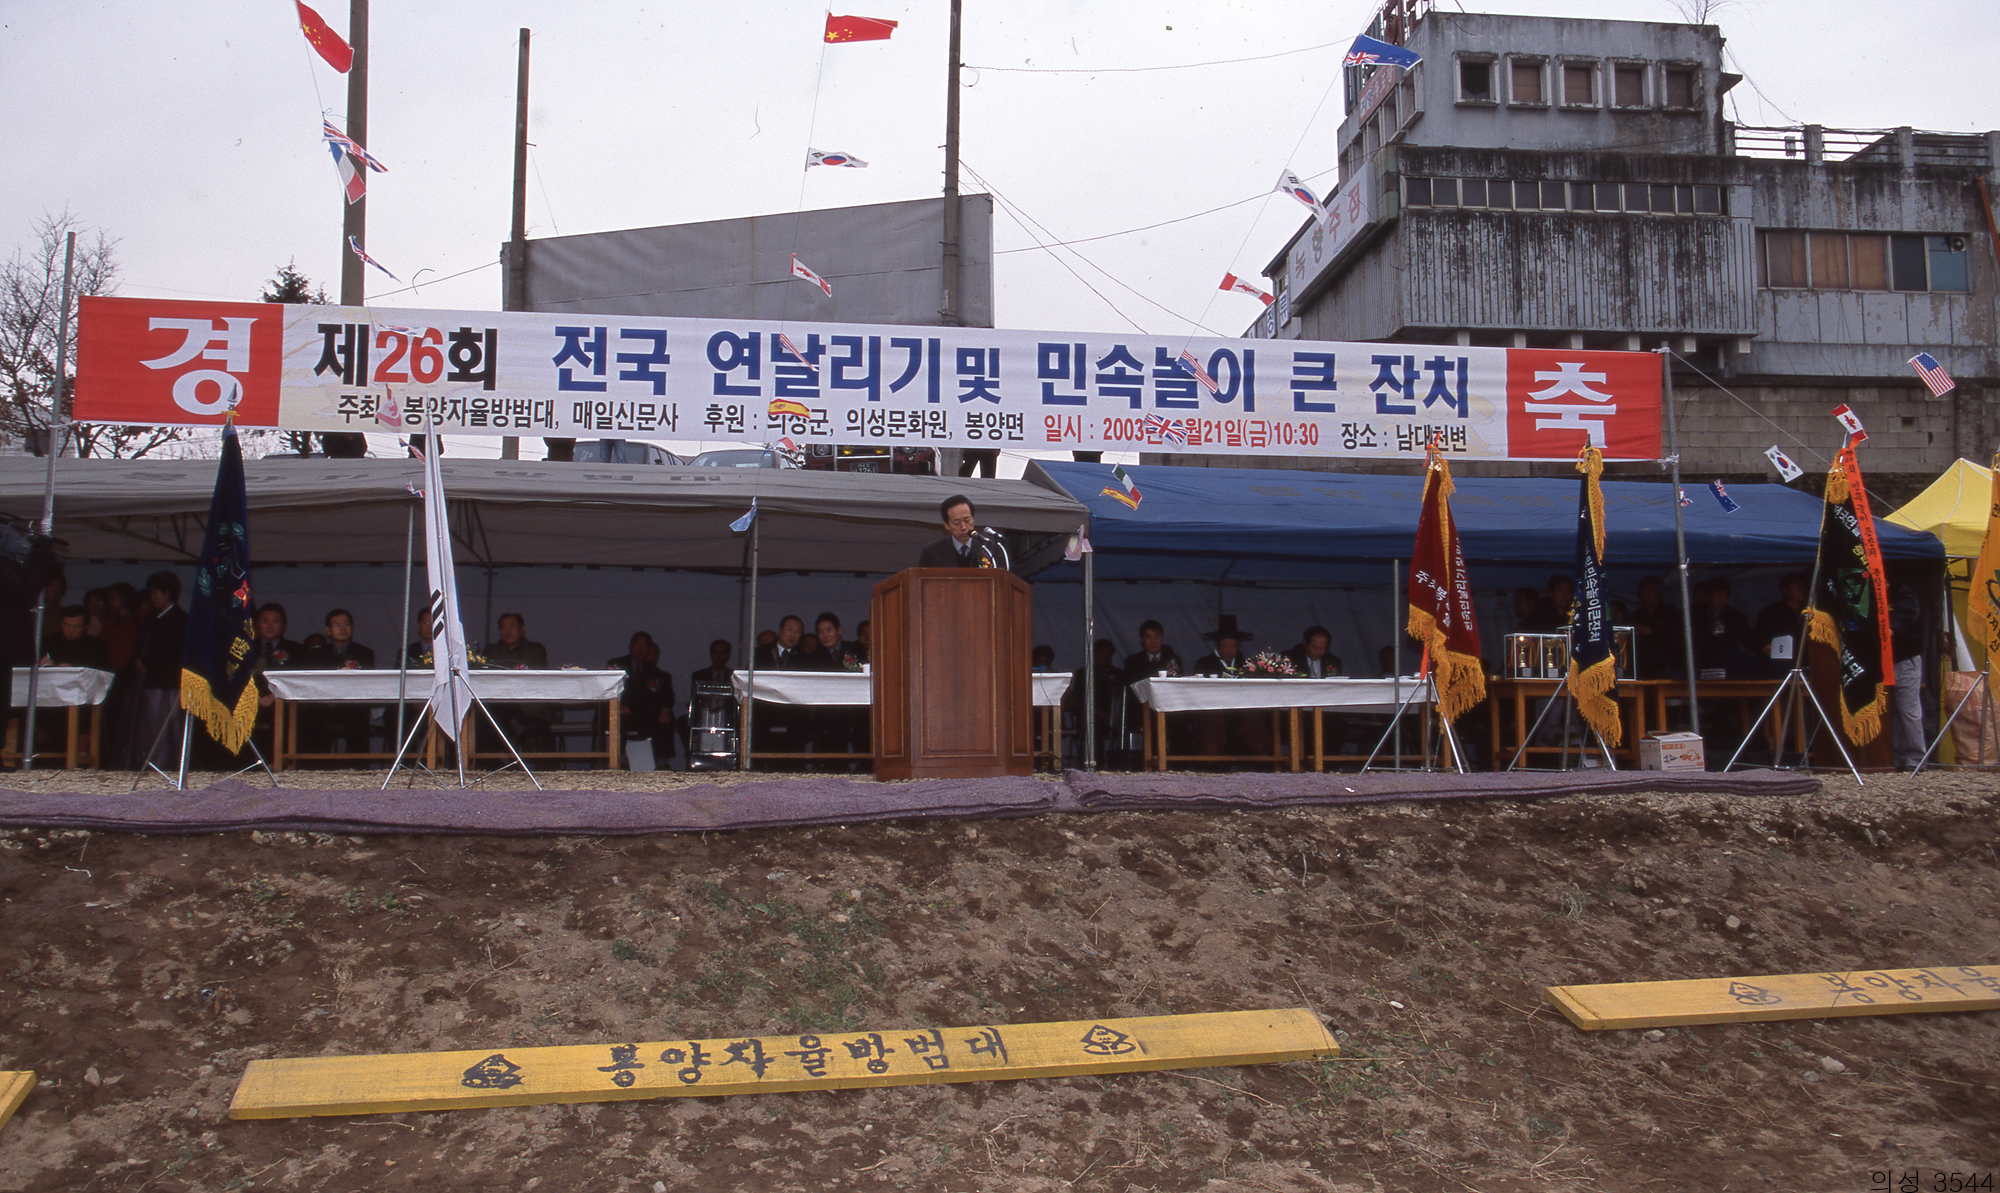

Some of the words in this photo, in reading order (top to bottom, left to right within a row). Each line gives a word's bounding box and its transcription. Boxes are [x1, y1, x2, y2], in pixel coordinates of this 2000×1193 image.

[140, 316, 259, 416] 경
[313, 323, 497, 391] 제26회
[545, 326, 671, 395] 전국
[1038, 342, 1255, 412] 민속놀이
[1287, 350, 1337, 413] 큰
[1369, 353, 1469, 419] 잔치
[1524, 361, 1617, 448] 축
[573, 399, 680, 433] 매일신문사
[845, 407, 953, 440] 의성문화원,
[964, 411, 1025, 442] 봉양면
[597, 1027, 1009, 1087] 봉양자율방범대
